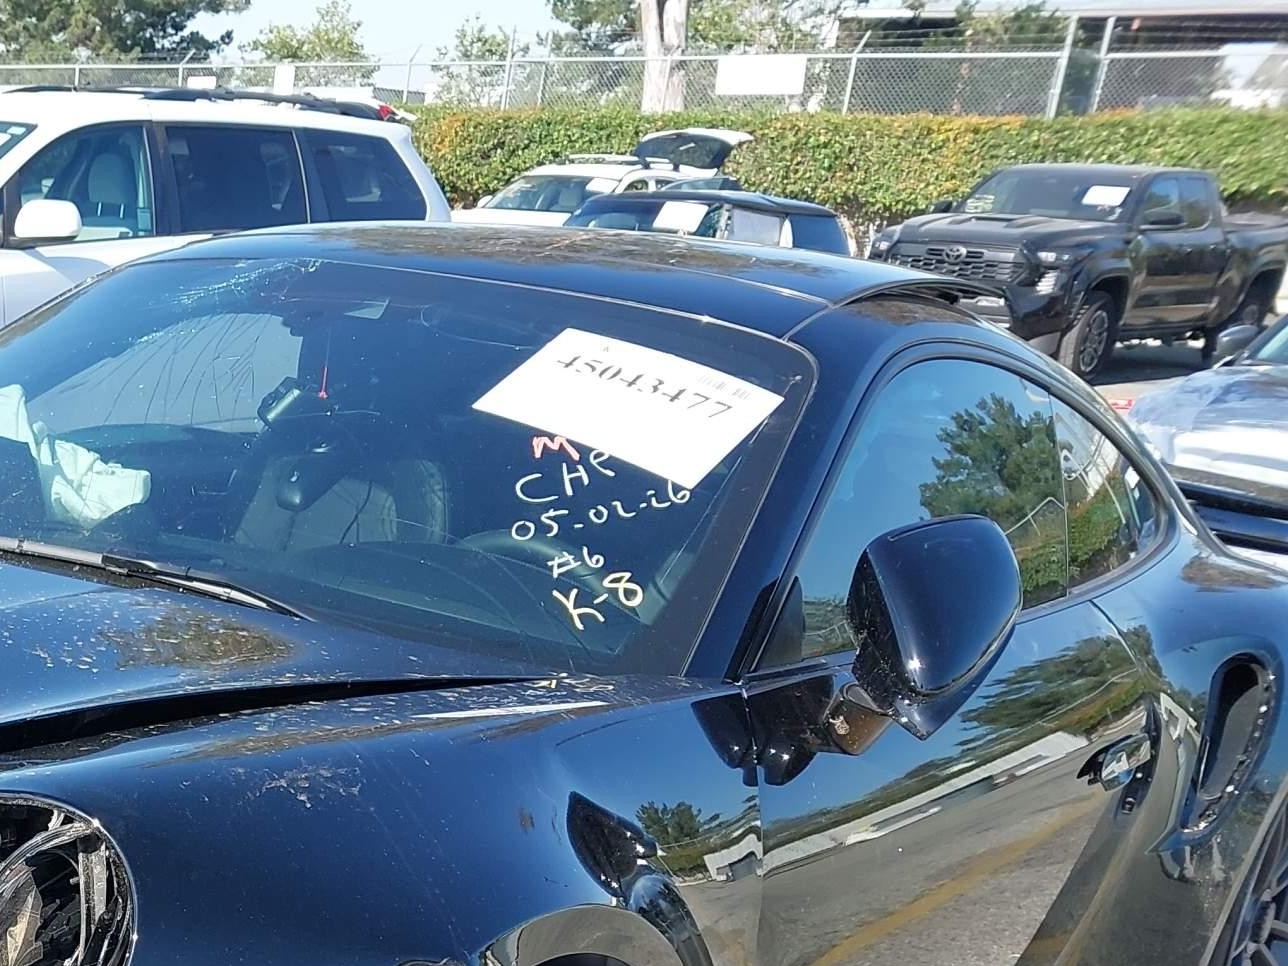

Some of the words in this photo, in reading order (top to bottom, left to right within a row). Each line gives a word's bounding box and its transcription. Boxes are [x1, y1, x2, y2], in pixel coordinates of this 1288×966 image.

[556, 354, 733, 419] 45043477
[546, 545, 605, 579] #6
[551, 571, 645, 632] K-8
